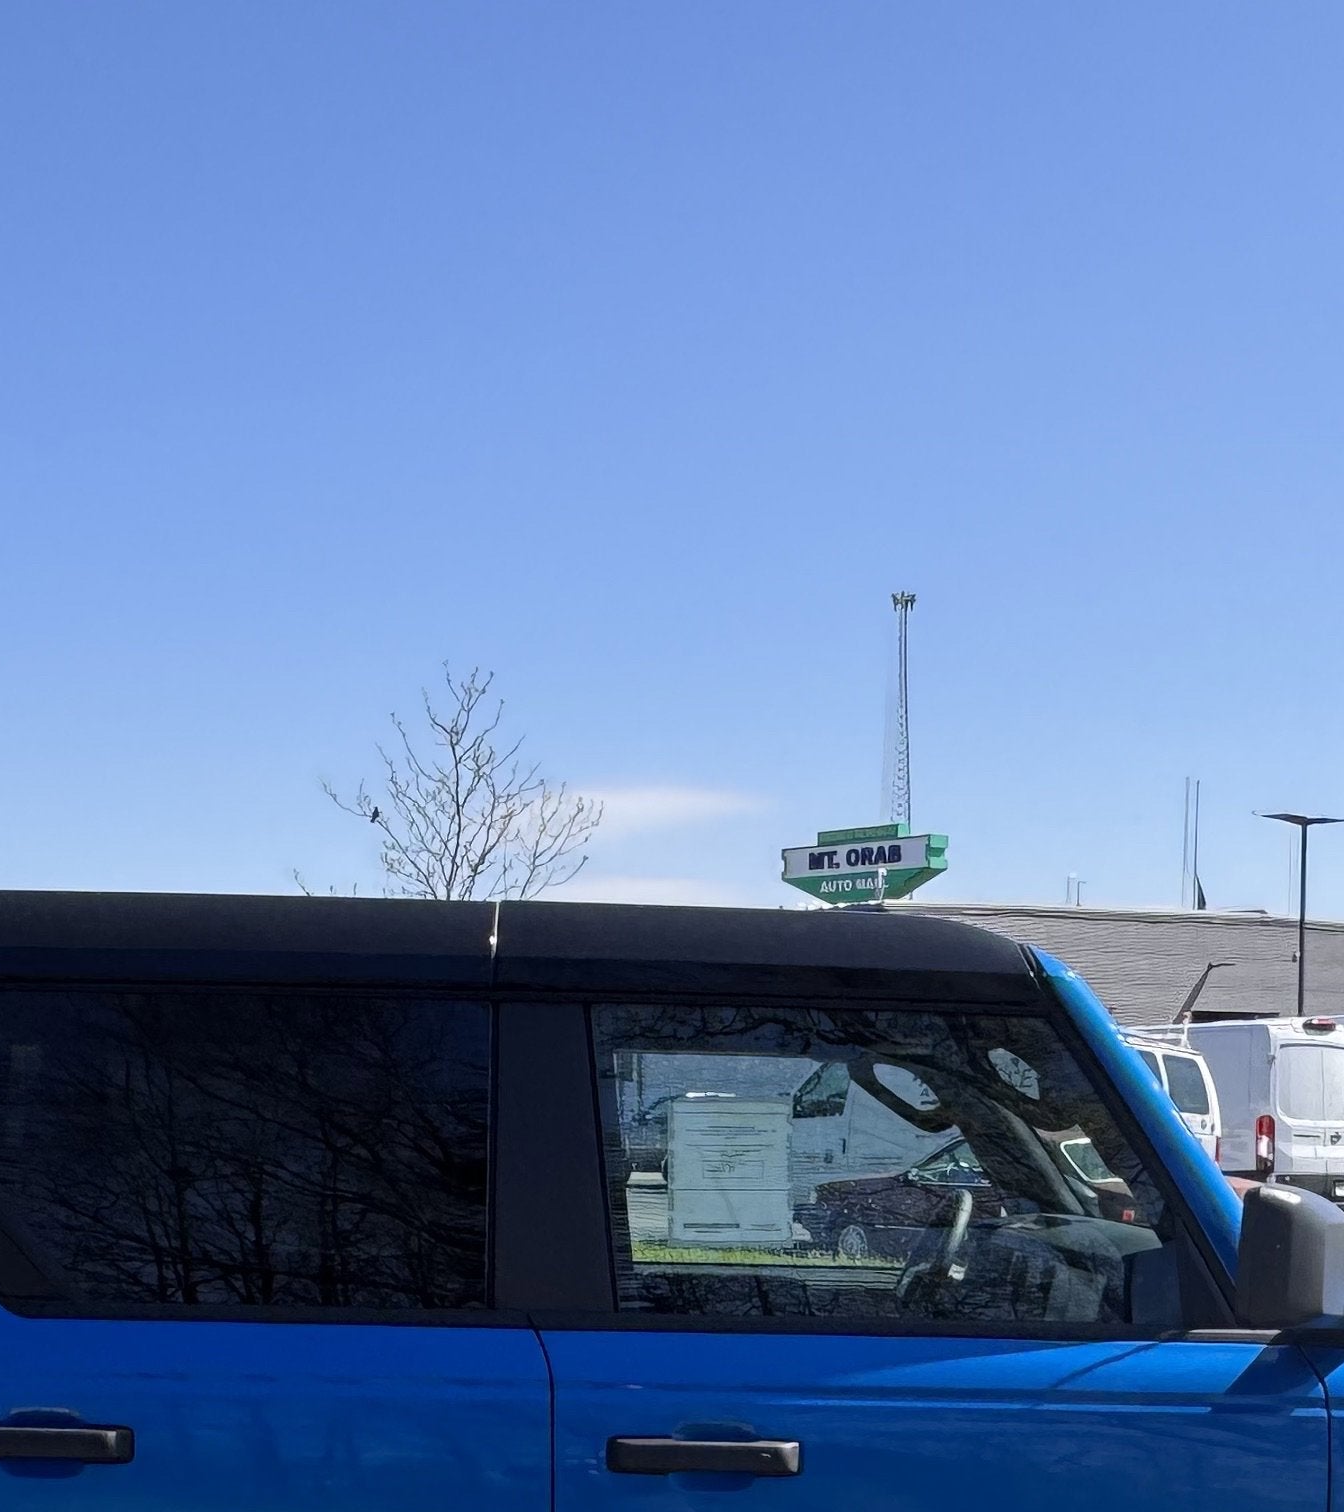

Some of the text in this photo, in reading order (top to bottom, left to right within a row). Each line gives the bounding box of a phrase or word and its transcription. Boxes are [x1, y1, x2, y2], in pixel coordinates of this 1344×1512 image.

[809, 845, 902, 870] MT. ORAB
[819, 879, 853, 894] AUTO
